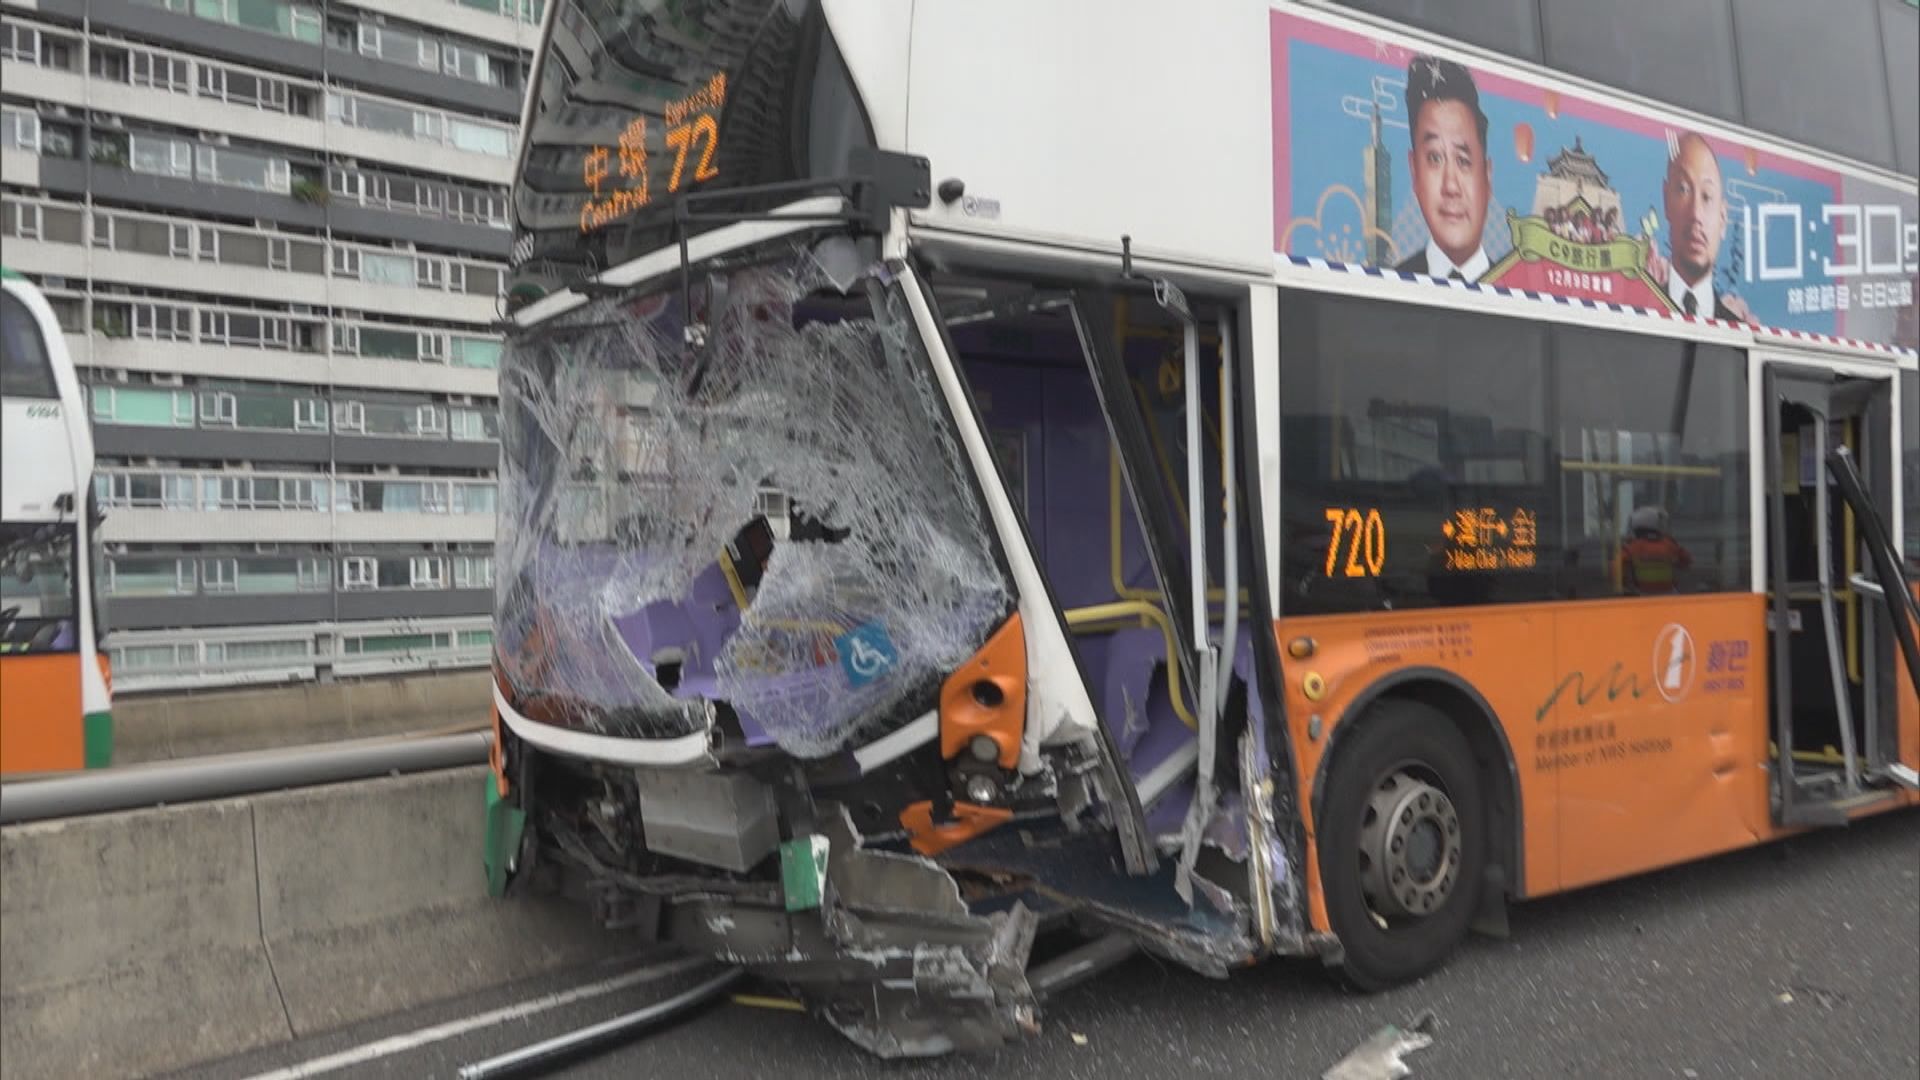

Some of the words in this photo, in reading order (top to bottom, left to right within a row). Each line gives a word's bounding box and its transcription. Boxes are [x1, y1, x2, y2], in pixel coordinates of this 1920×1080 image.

[580, 170, 651, 234] Central
[1743, 203, 1902, 283] 10:30
[1325, 507, 1385, 578] 720
